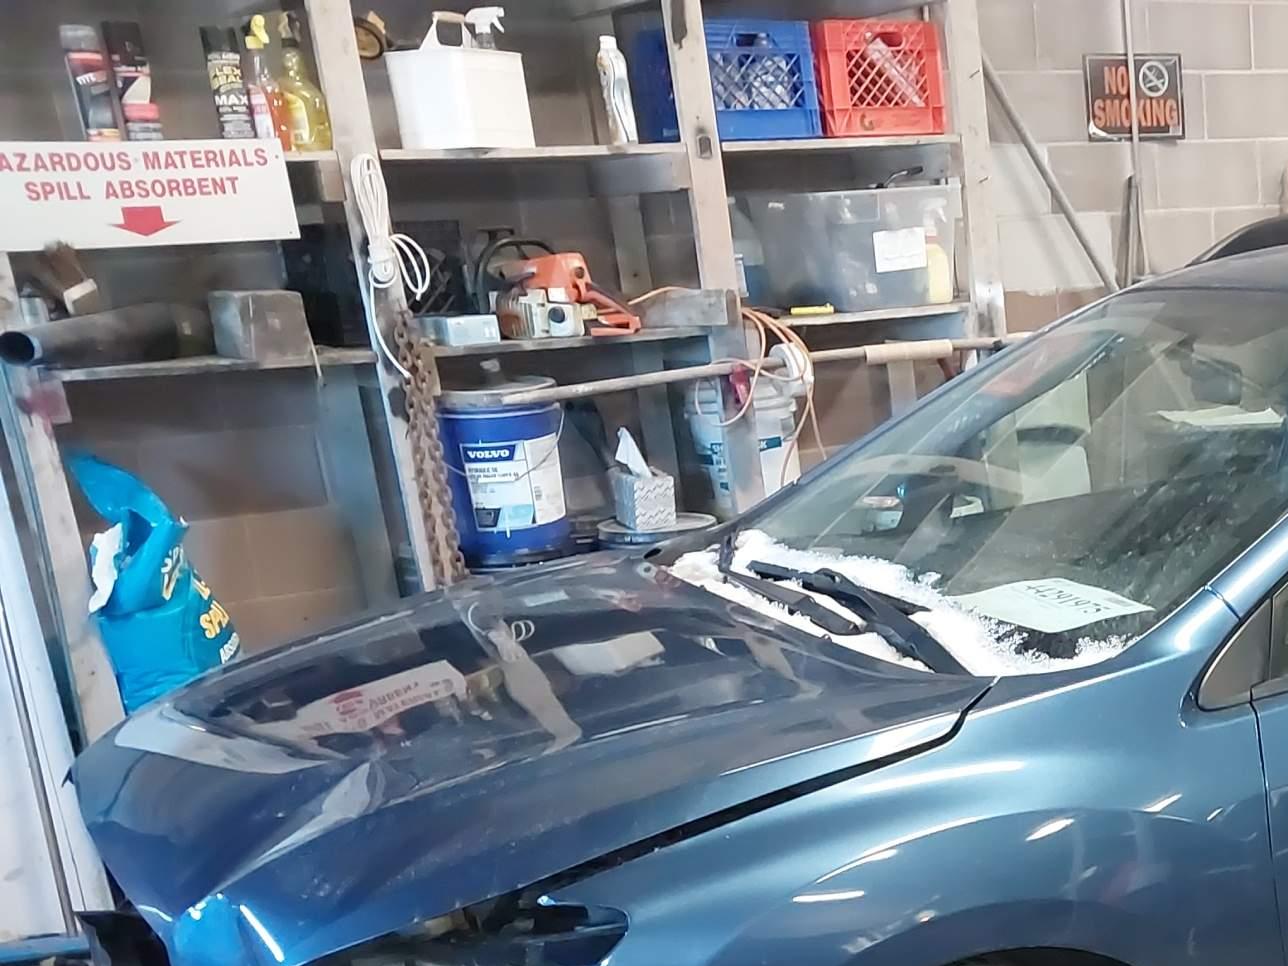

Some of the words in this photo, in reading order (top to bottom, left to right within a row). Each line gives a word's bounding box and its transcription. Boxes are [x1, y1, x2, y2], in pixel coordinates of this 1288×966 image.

[1103, 65, 1129, 96] NO
[214, 93, 249, 106] MAX
[0, 151, 132, 172] AZARDOUS
[143, 148, 268, 170] MATERIALS
[24, 181, 91, 202] SPILL
[105, 176, 239, 200] ABSORBENT
[467, 448, 511, 459] VOLVO
